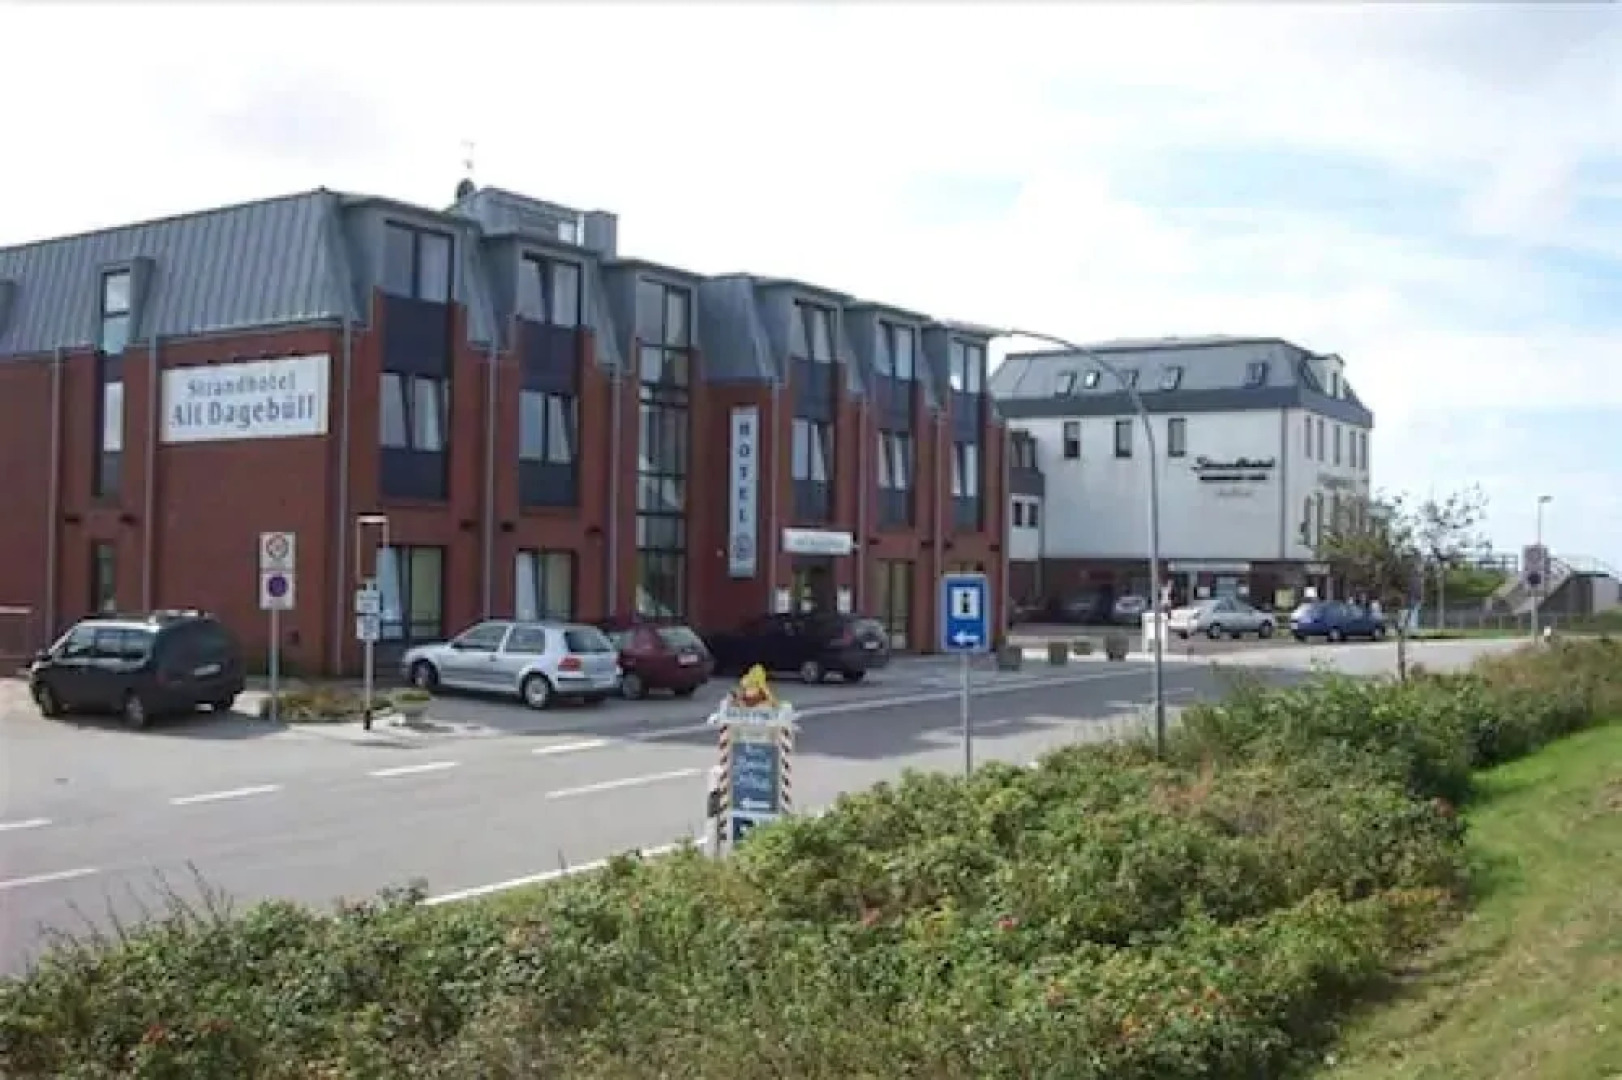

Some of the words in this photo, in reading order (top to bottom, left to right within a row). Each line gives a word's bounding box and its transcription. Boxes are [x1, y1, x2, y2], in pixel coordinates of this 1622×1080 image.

[188, 371, 296, 396] Strandhotel
[173, 402, 202, 426] Alt
[208, 394, 315, 429] Dagebüll
[738, 422, 751, 523] HOTEL
